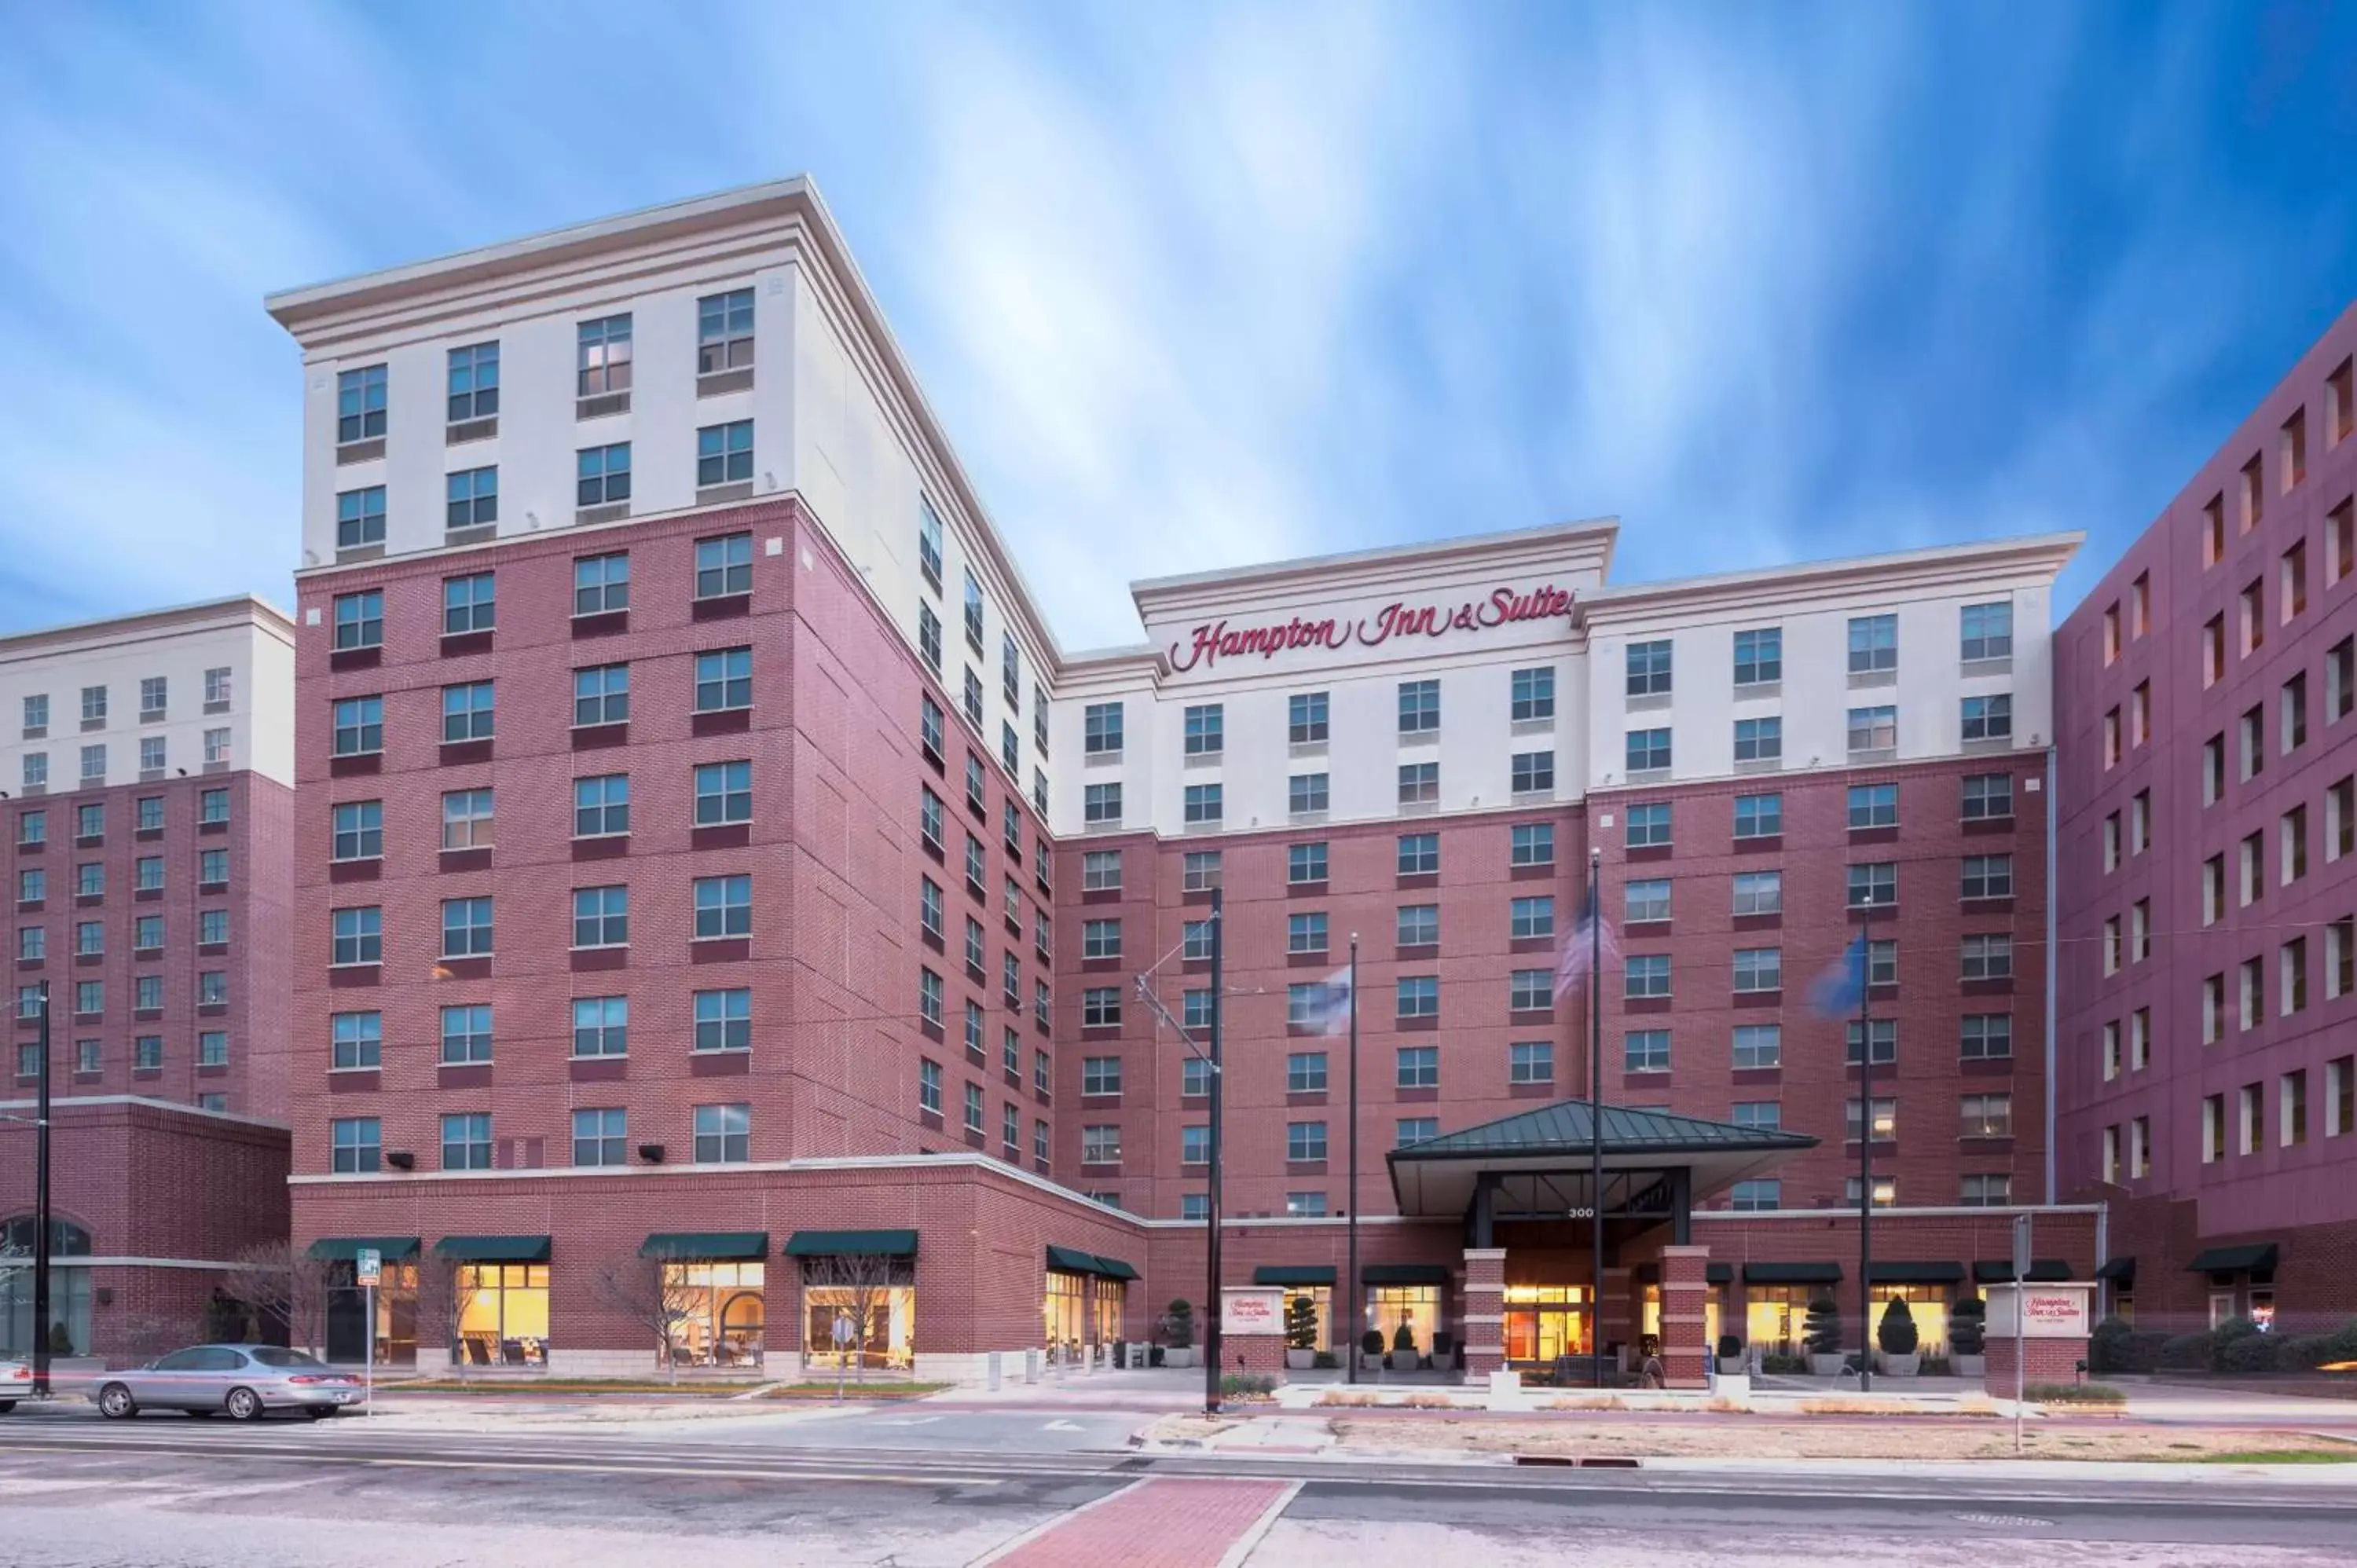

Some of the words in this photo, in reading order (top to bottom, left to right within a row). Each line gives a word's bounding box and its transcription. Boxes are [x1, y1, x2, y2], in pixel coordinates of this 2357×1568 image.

[1171, 616, 1351, 672] Hampton
[1358, 602, 1452, 646] Inn
[1453, 603, 1479, 631] &
[1568, 1207, 1594, 1218] 300
